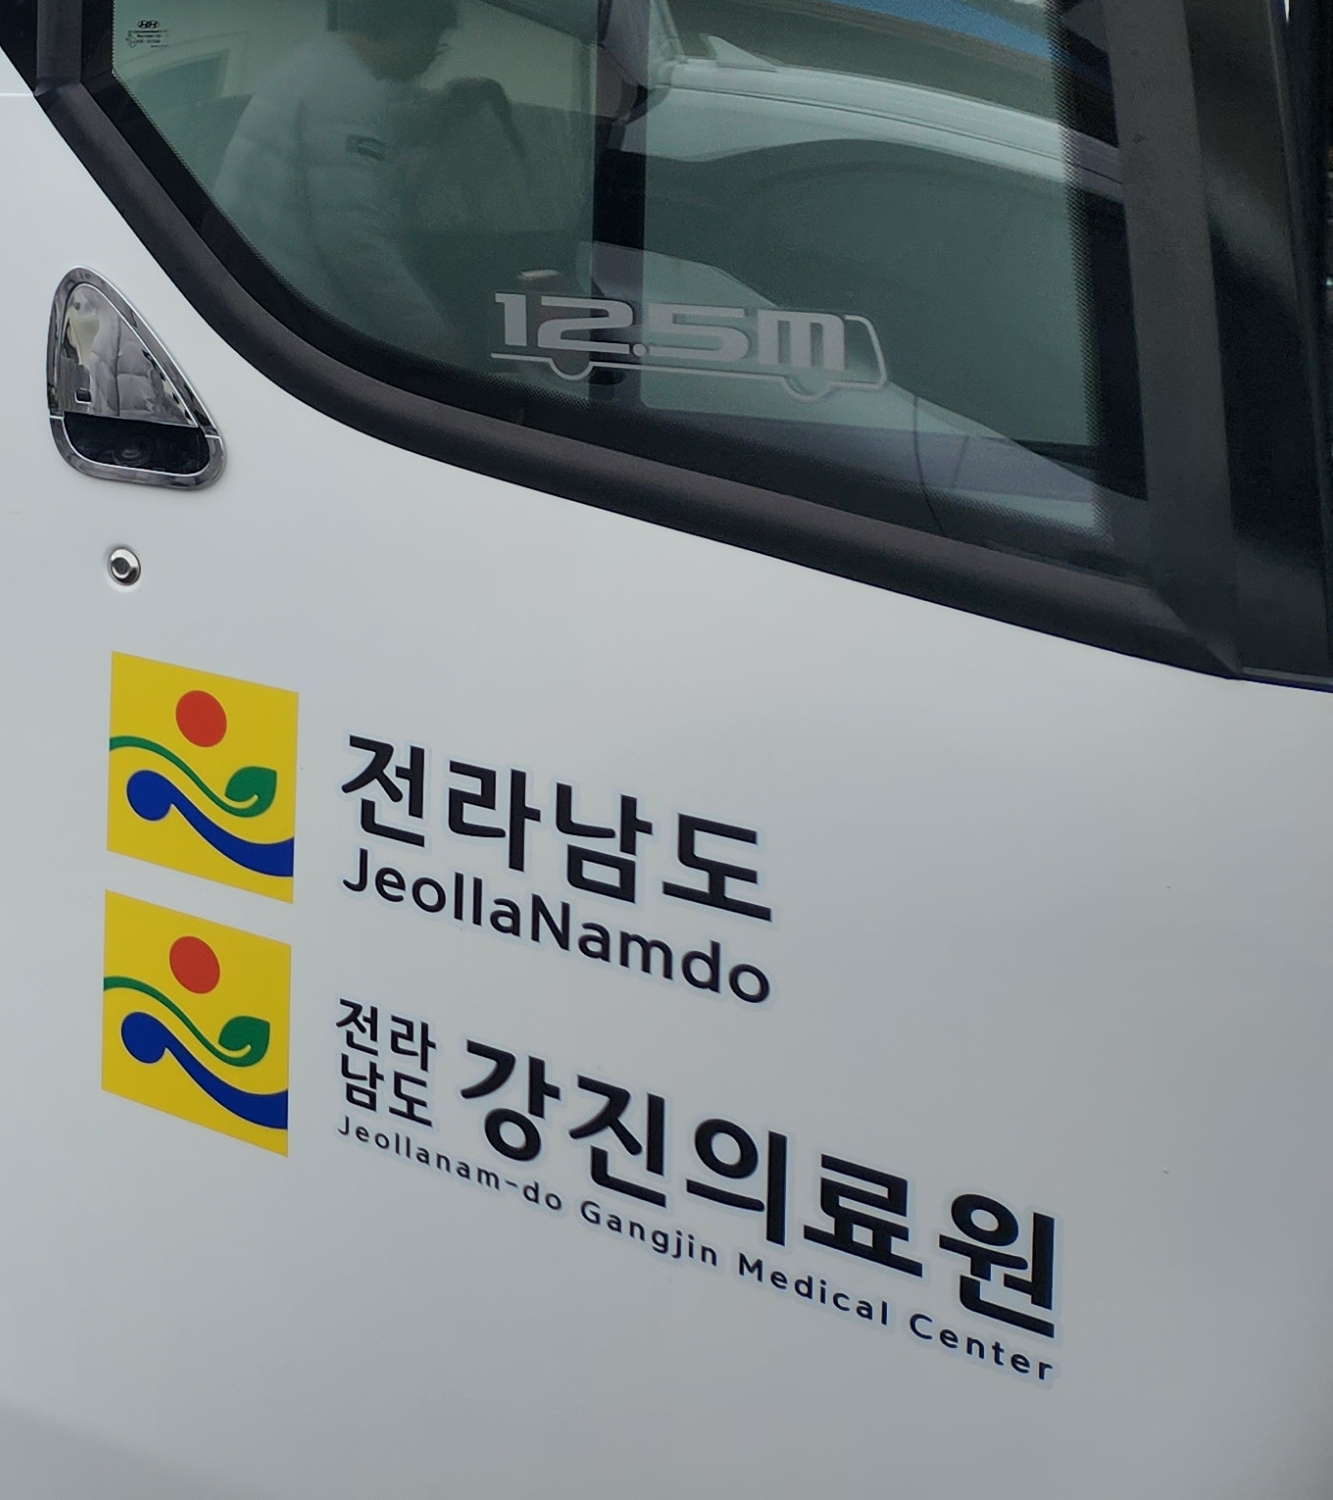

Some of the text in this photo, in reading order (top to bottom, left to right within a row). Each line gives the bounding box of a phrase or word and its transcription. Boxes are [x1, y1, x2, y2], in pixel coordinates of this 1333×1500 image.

[341, 735, 772, 922] 전라남도
[342, 848, 770, 1004] JeollaNamdo
[338, 1115, 1053, 1380] Jeollanam-do Gangjin Medical Center
[460, 1039, 1055, 1339] 강진의료원
